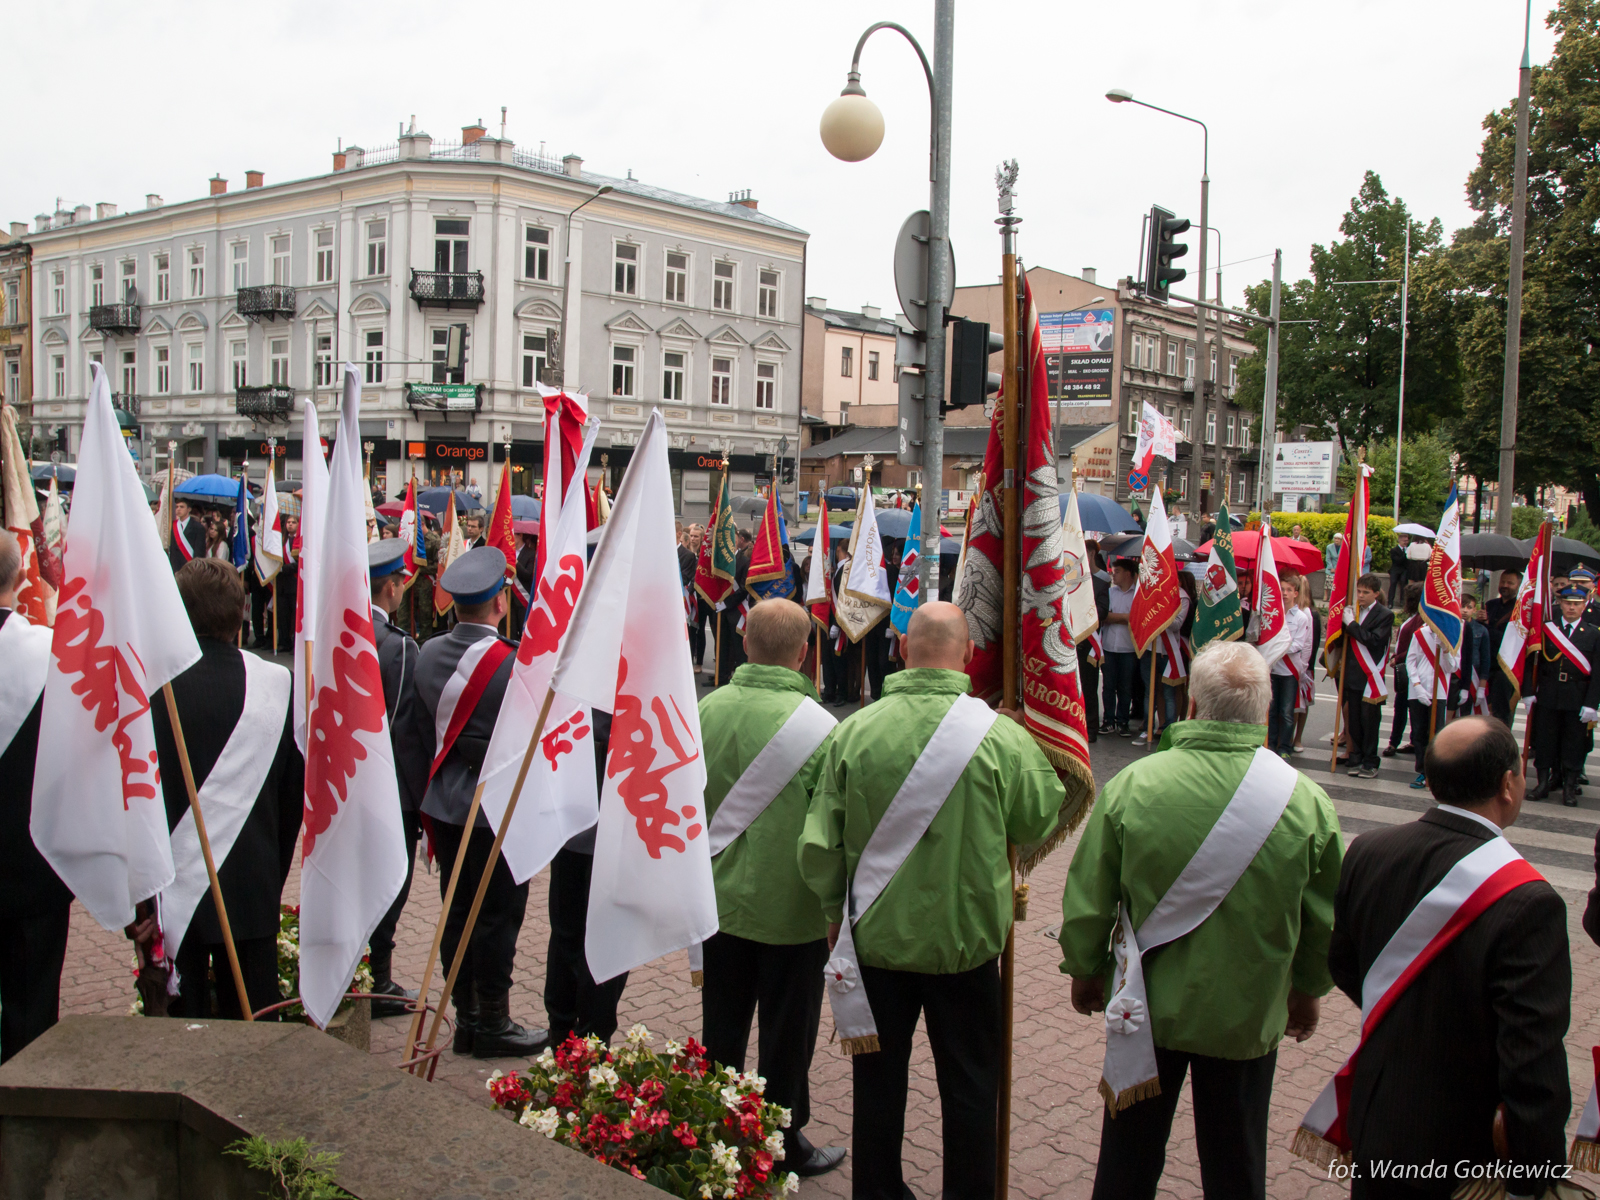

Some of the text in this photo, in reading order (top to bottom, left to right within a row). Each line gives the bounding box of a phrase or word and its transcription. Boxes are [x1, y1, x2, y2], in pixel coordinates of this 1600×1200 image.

[436, 444, 484, 460] Orange
[697, 456, 723, 470] Orang
[1077, 468, 1112, 478] LOMBARD
[1141, 602, 1165, 629] NAUKA
